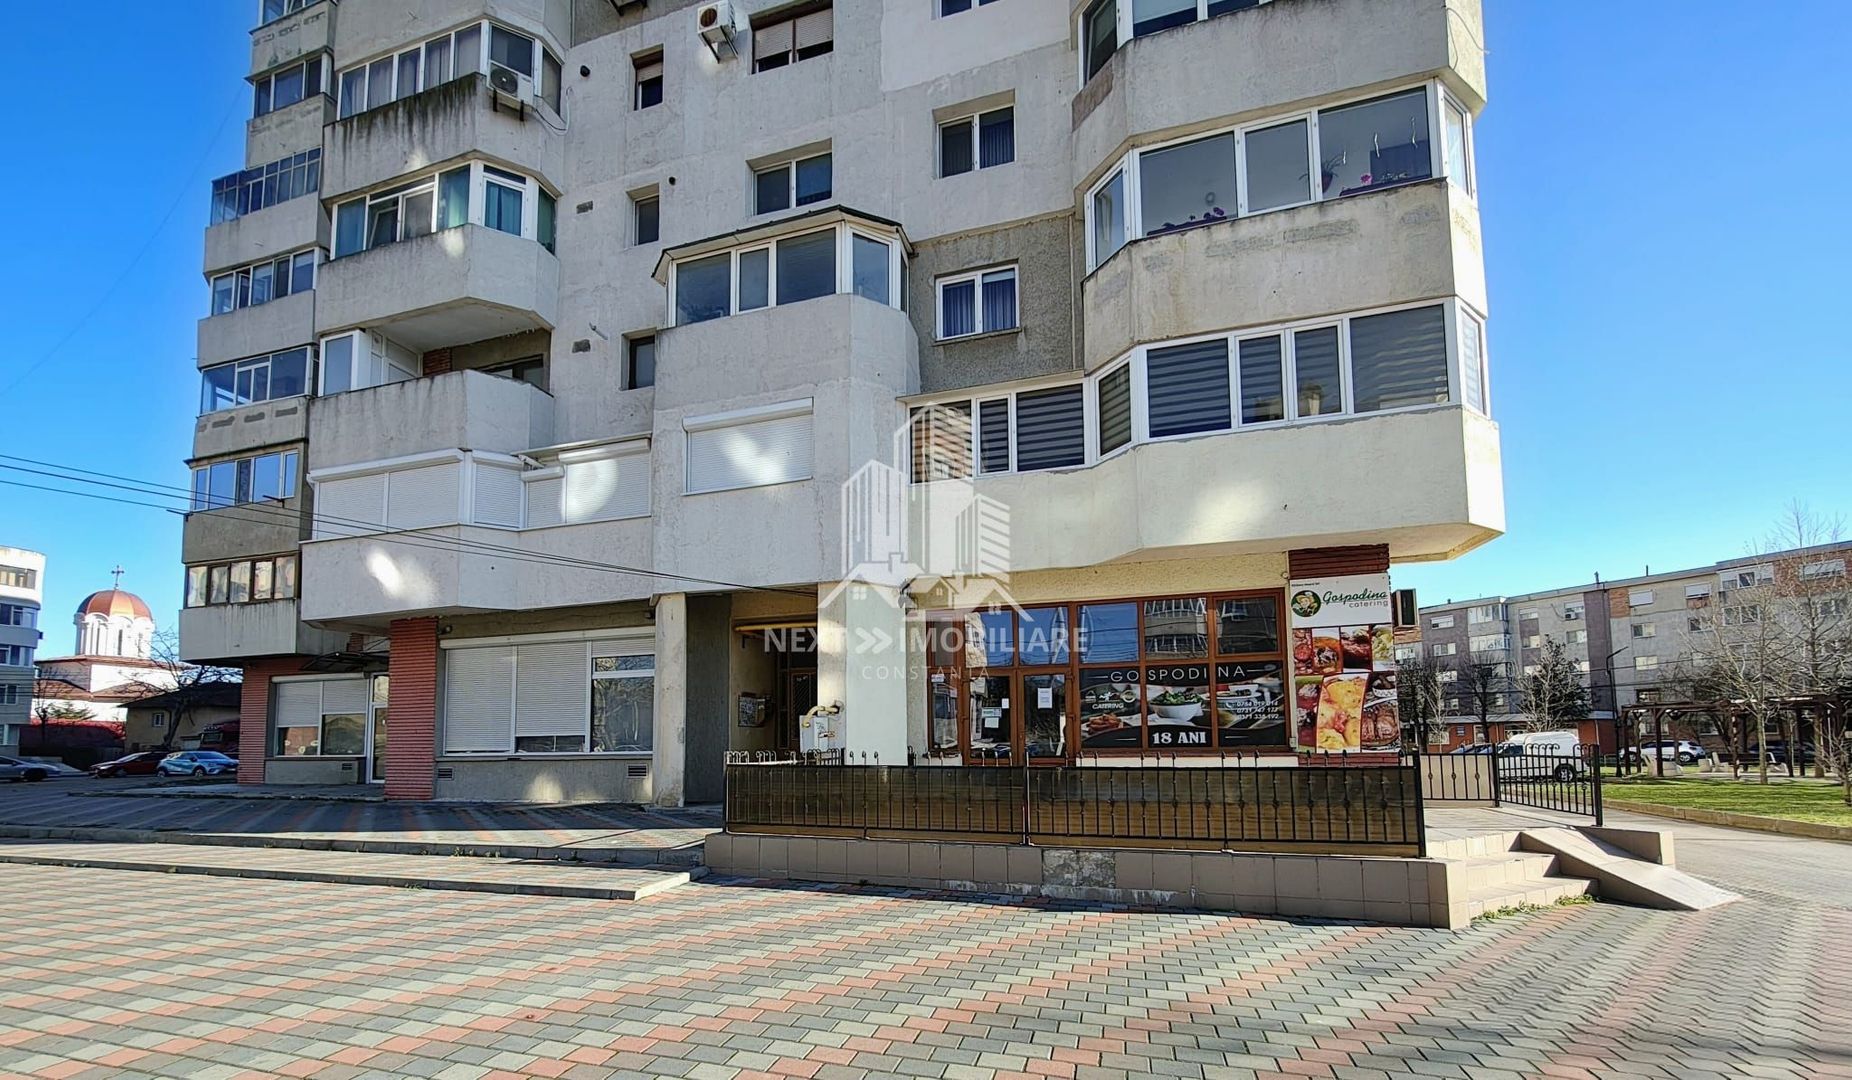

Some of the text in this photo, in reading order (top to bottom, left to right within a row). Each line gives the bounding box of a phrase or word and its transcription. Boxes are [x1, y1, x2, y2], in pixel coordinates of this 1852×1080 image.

[1322, 587, 1388, 605] Gospodina
[1348, 599, 1389, 609] catering
[1091, 702, 1125, 710] CATERING
[1152, 731, 1207, 744] 18 ANI
